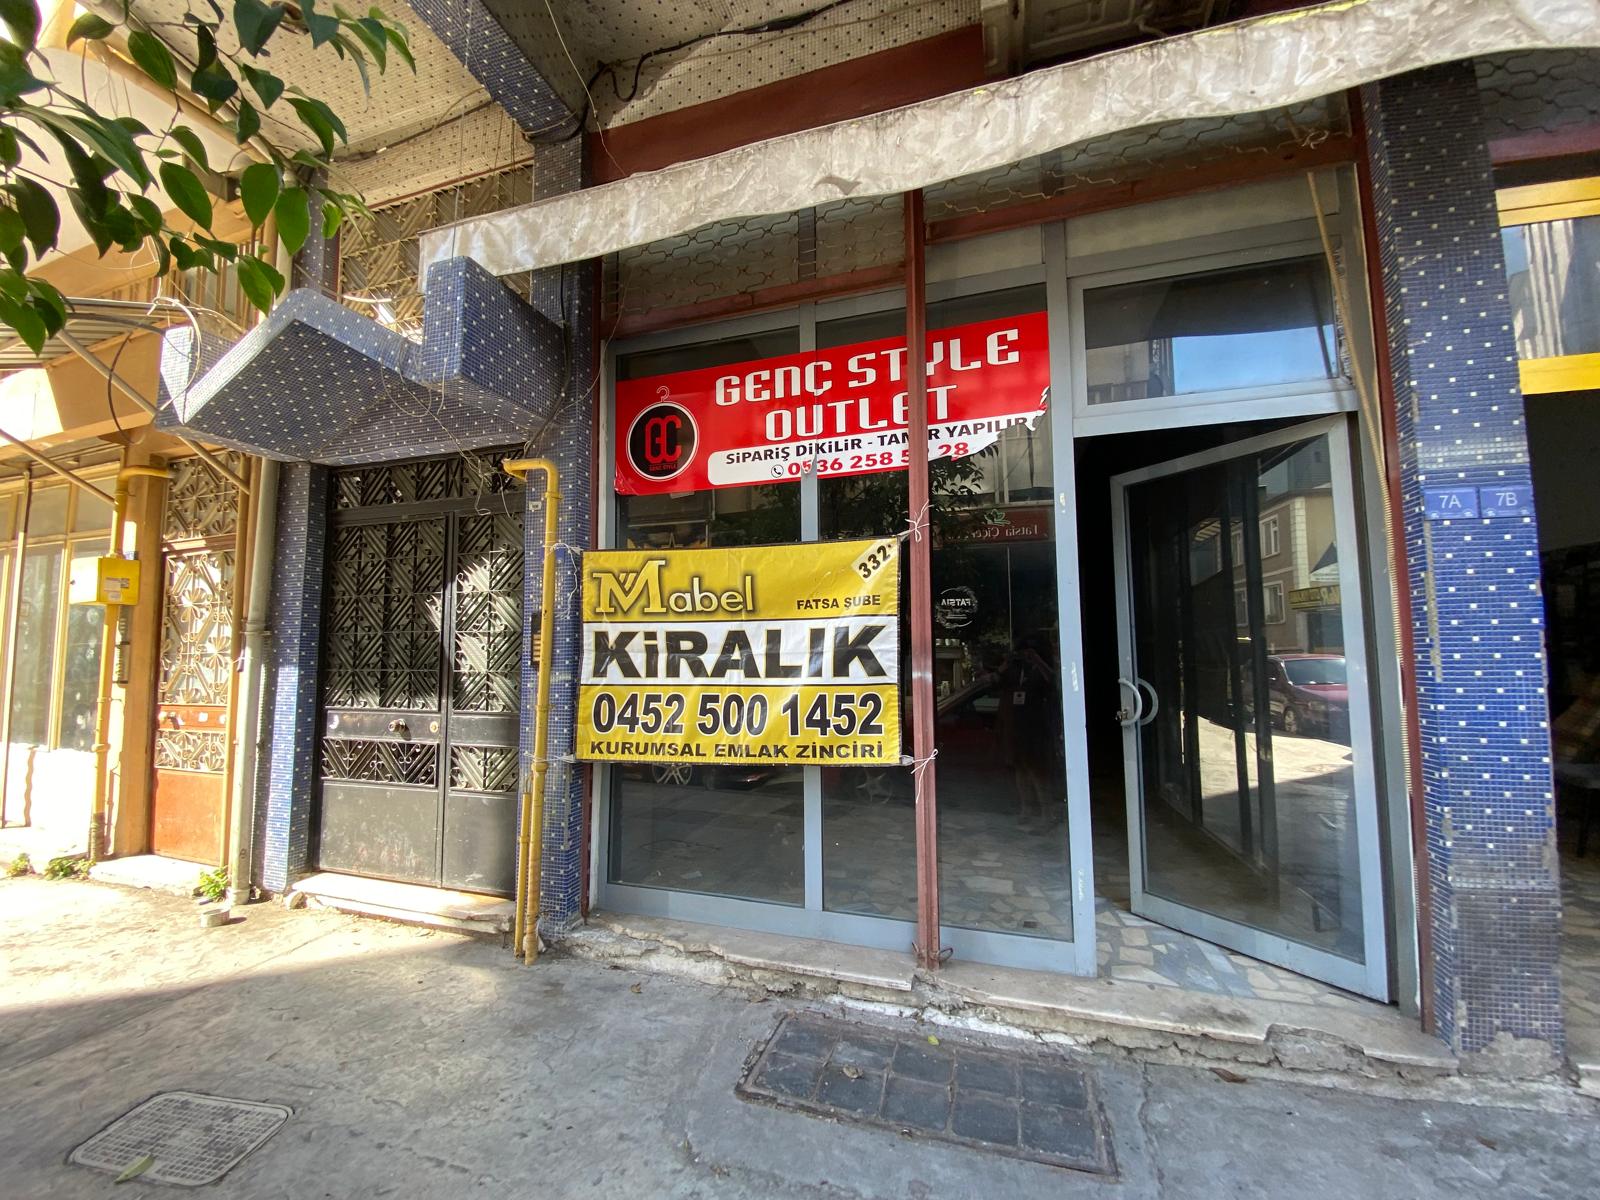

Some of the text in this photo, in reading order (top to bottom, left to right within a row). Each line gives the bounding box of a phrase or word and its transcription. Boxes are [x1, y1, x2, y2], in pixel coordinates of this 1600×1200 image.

[715, 361, 832, 406] GENÇ
[788, 458, 843, 475] 0536
[850, 452, 893, 469] 258
[938, 442, 969, 457] 28
[1438, 494, 1462, 509] 7A
[1495, 492, 1518, 507] 7B
[858, 544, 891, 579] 332
[592, 559, 754, 614] Mabel
[796, 598, 840, 610] FATSA
[592, 691, 884, 737] 0452 500 1452
[590, 741, 707, 757] KURUMSAL
[714, 743, 789, 759] EMLAK
